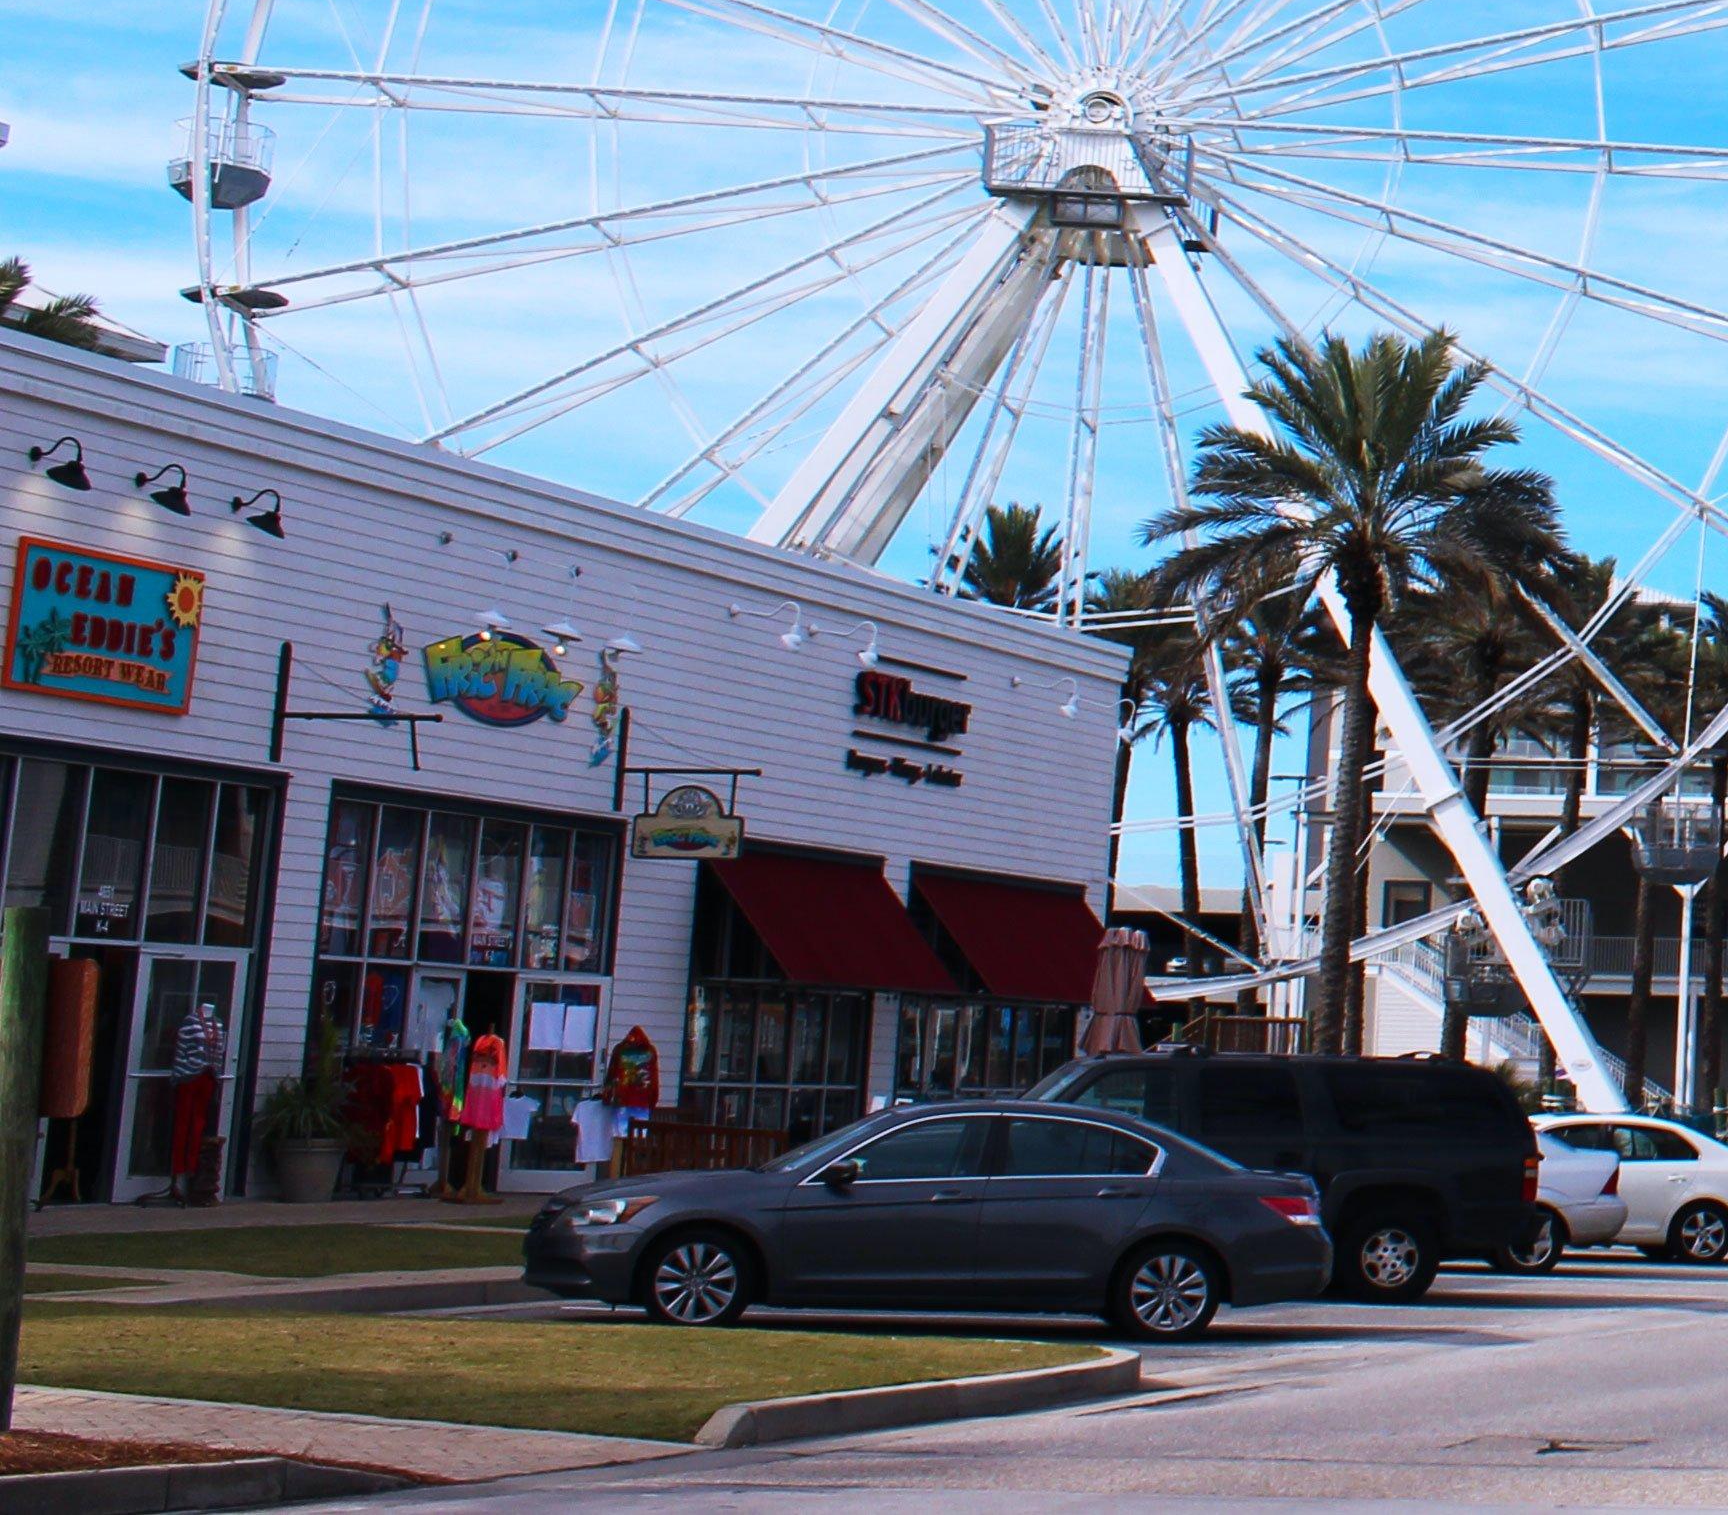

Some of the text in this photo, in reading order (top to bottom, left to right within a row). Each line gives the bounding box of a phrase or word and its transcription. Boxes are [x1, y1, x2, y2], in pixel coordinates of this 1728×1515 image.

[33, 556, 136, 607] OCEAN
[70, 612, 176, 663] EDDIE'S
[51, 653, 167, 693] RESORT WEAR
[101, 901, 129, 918] STREET
